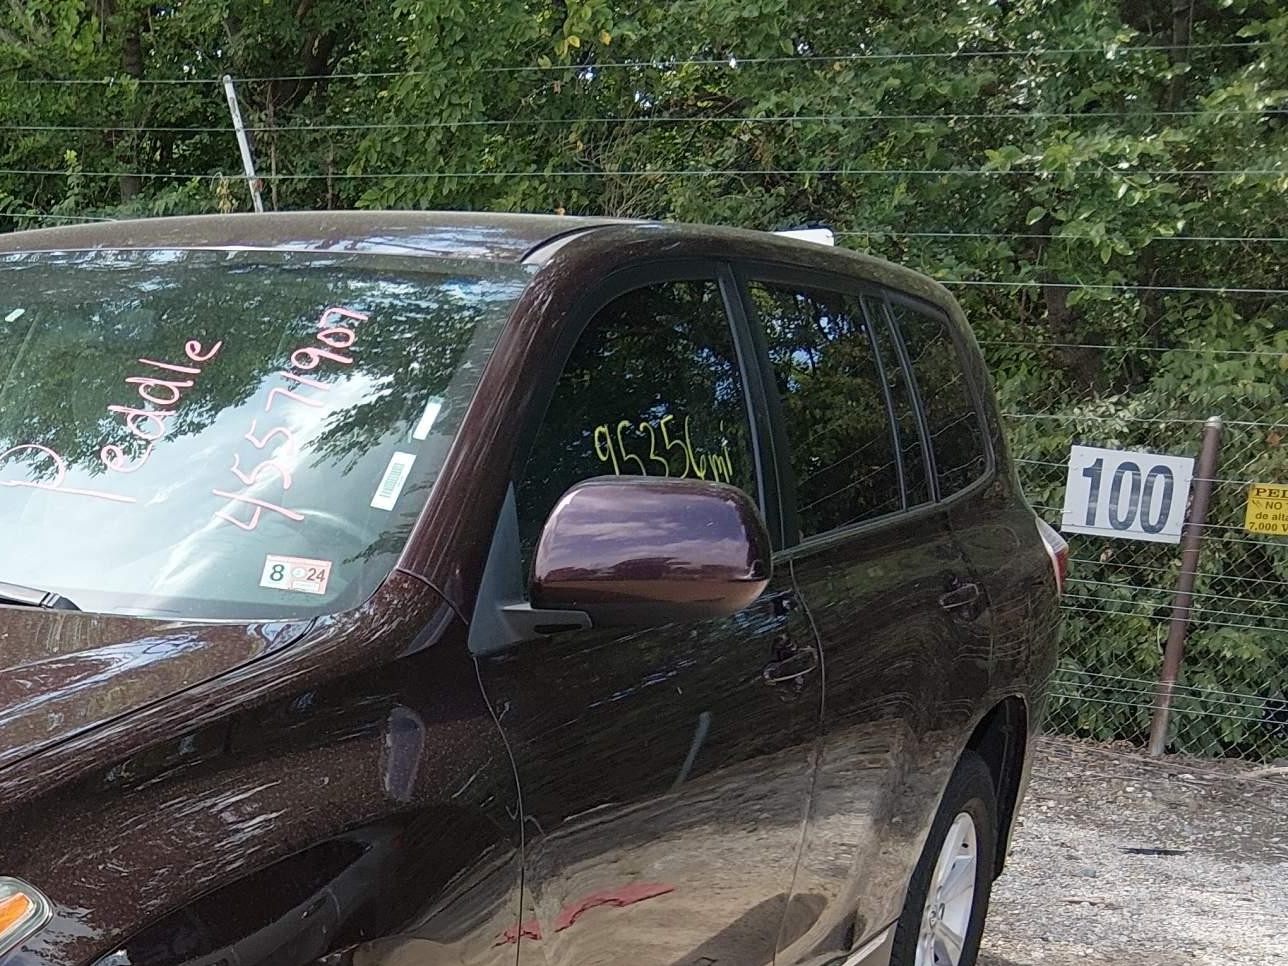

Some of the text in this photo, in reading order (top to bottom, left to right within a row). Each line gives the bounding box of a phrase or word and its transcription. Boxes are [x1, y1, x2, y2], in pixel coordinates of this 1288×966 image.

[212, 307, 369, 530] 45571907
[1082, 458, 1174, 534] 100
[270, 564, 326, 583] 8 24
